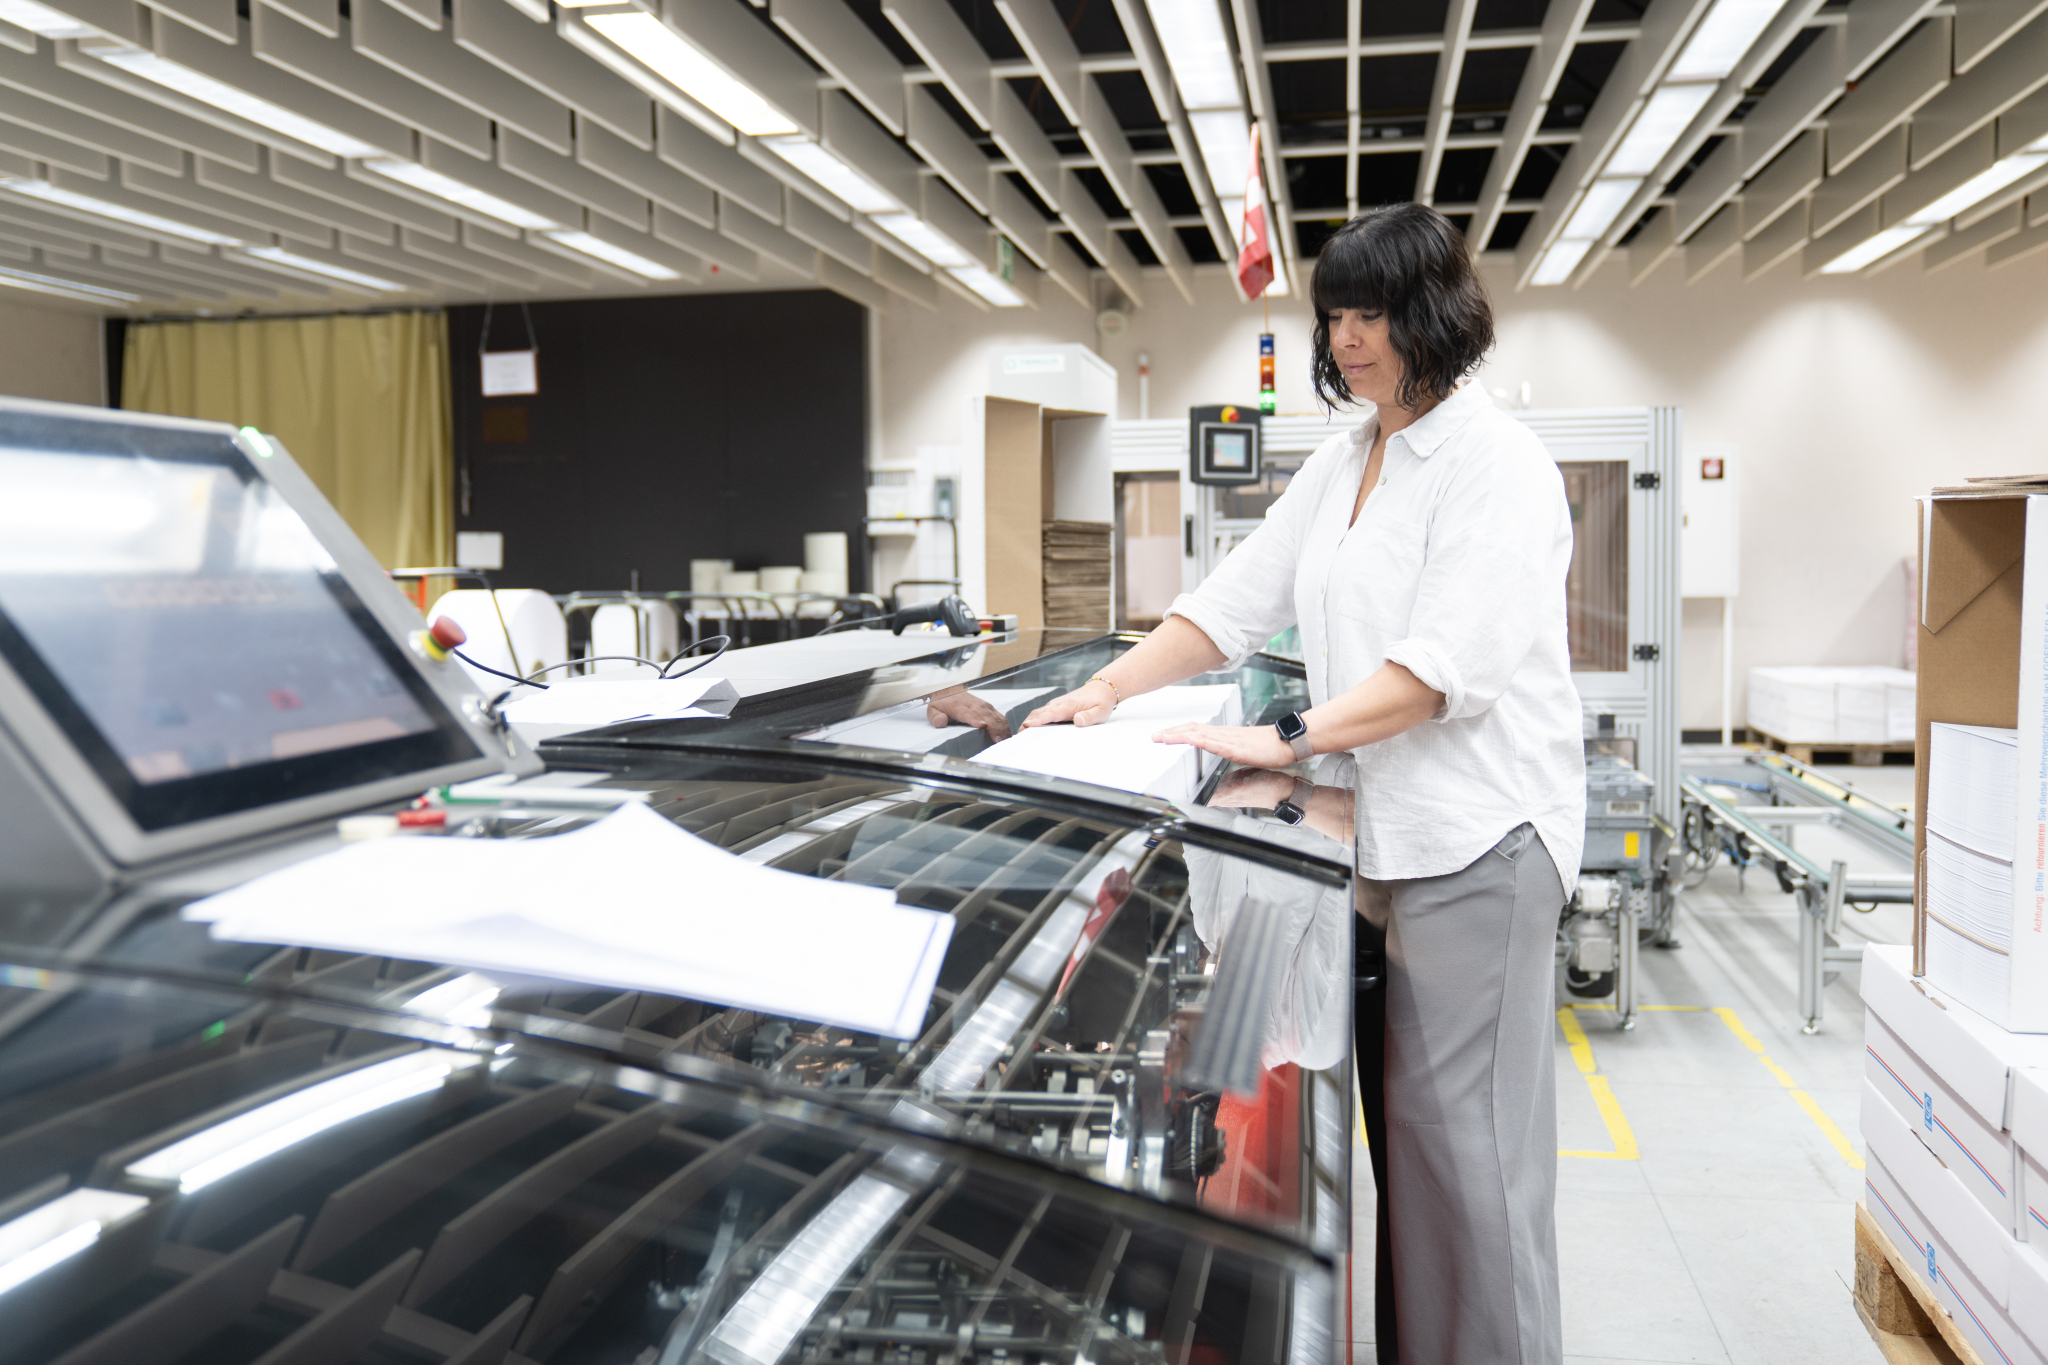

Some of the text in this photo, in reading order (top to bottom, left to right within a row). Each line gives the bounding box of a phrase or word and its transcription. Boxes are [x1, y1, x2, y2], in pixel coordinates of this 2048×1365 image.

[2039, 696, 2048, 779] Mehrwegschachtel
[2038, 781, 2048, 805] diese
[2037, 807, 2047, 821] Sie
[2036, 823, 2046, 870] retournieren
[2034, 871, 2044, 892] Bitte
[2033, 893, 2045, 934] Achtung:
